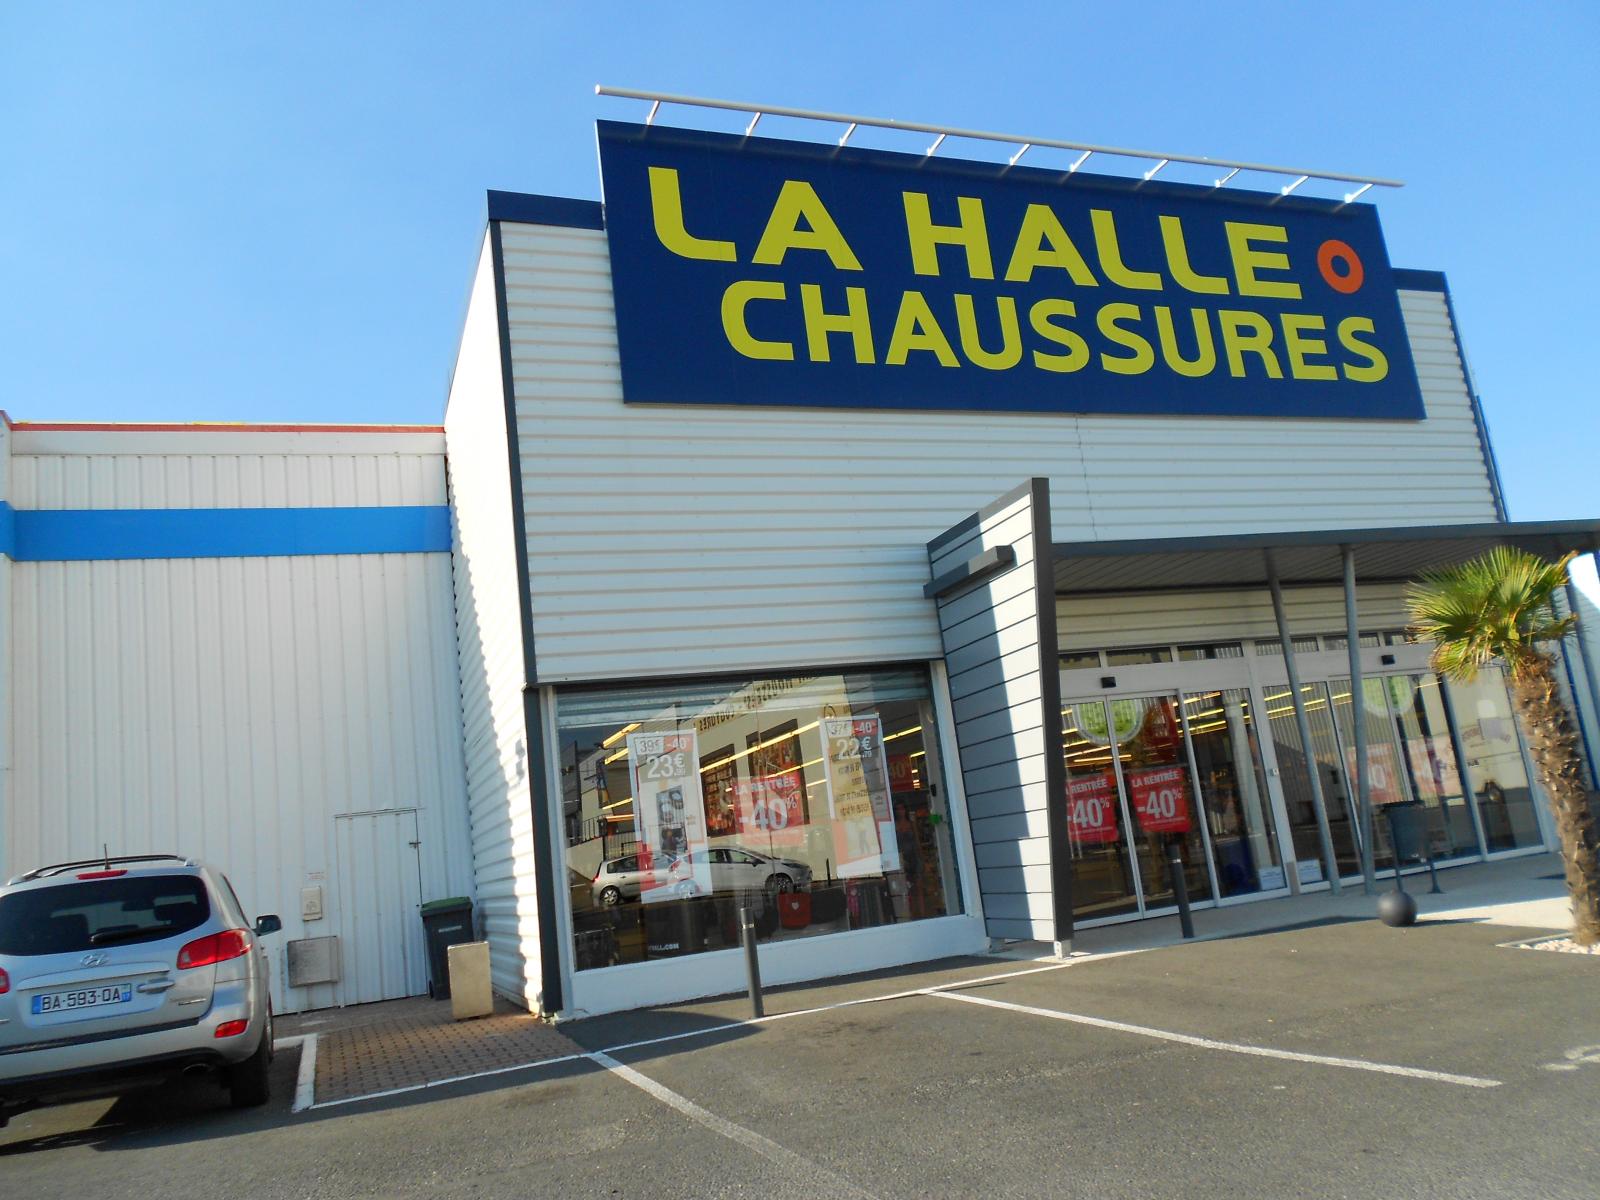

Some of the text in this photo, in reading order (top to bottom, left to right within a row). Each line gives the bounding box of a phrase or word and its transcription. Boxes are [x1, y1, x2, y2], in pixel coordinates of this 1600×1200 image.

[648, 166, 863, 271] LA
[903, 191, 1302, 300] HALLE
[721, 280, 1389, 383] CHAUSSURES
[1131, 777, 1144, 788] LA
